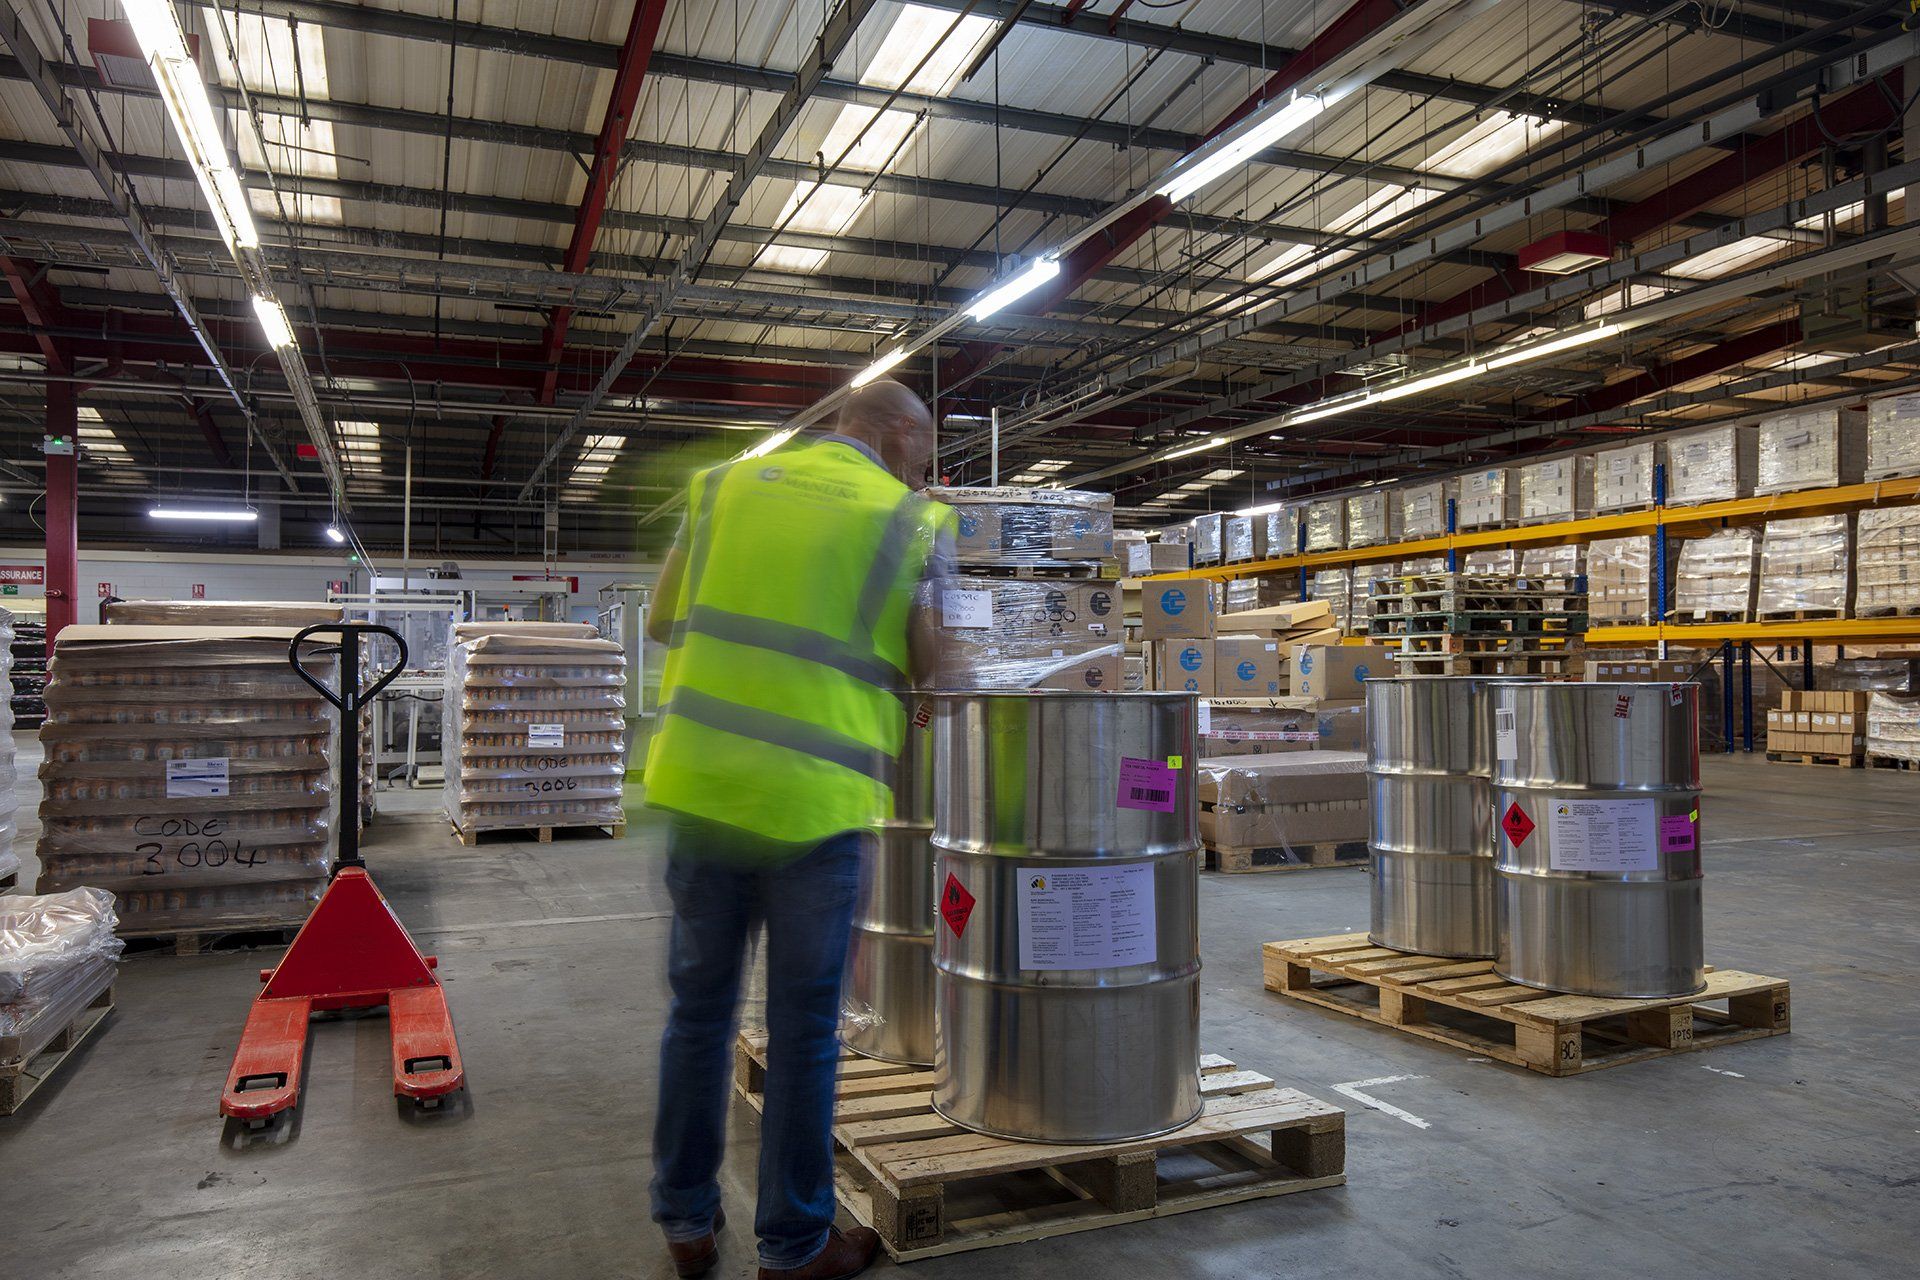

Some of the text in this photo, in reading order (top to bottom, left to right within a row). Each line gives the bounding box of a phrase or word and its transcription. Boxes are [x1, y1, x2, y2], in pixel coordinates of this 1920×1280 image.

[0, 570, 42, 580] SSURANCE
[520, 757, 568, 772] CODE
[525, 777, 577, 797] 3006
[135, 817, 222, 836] CODE
[136, 840, 267, 875] 3004
